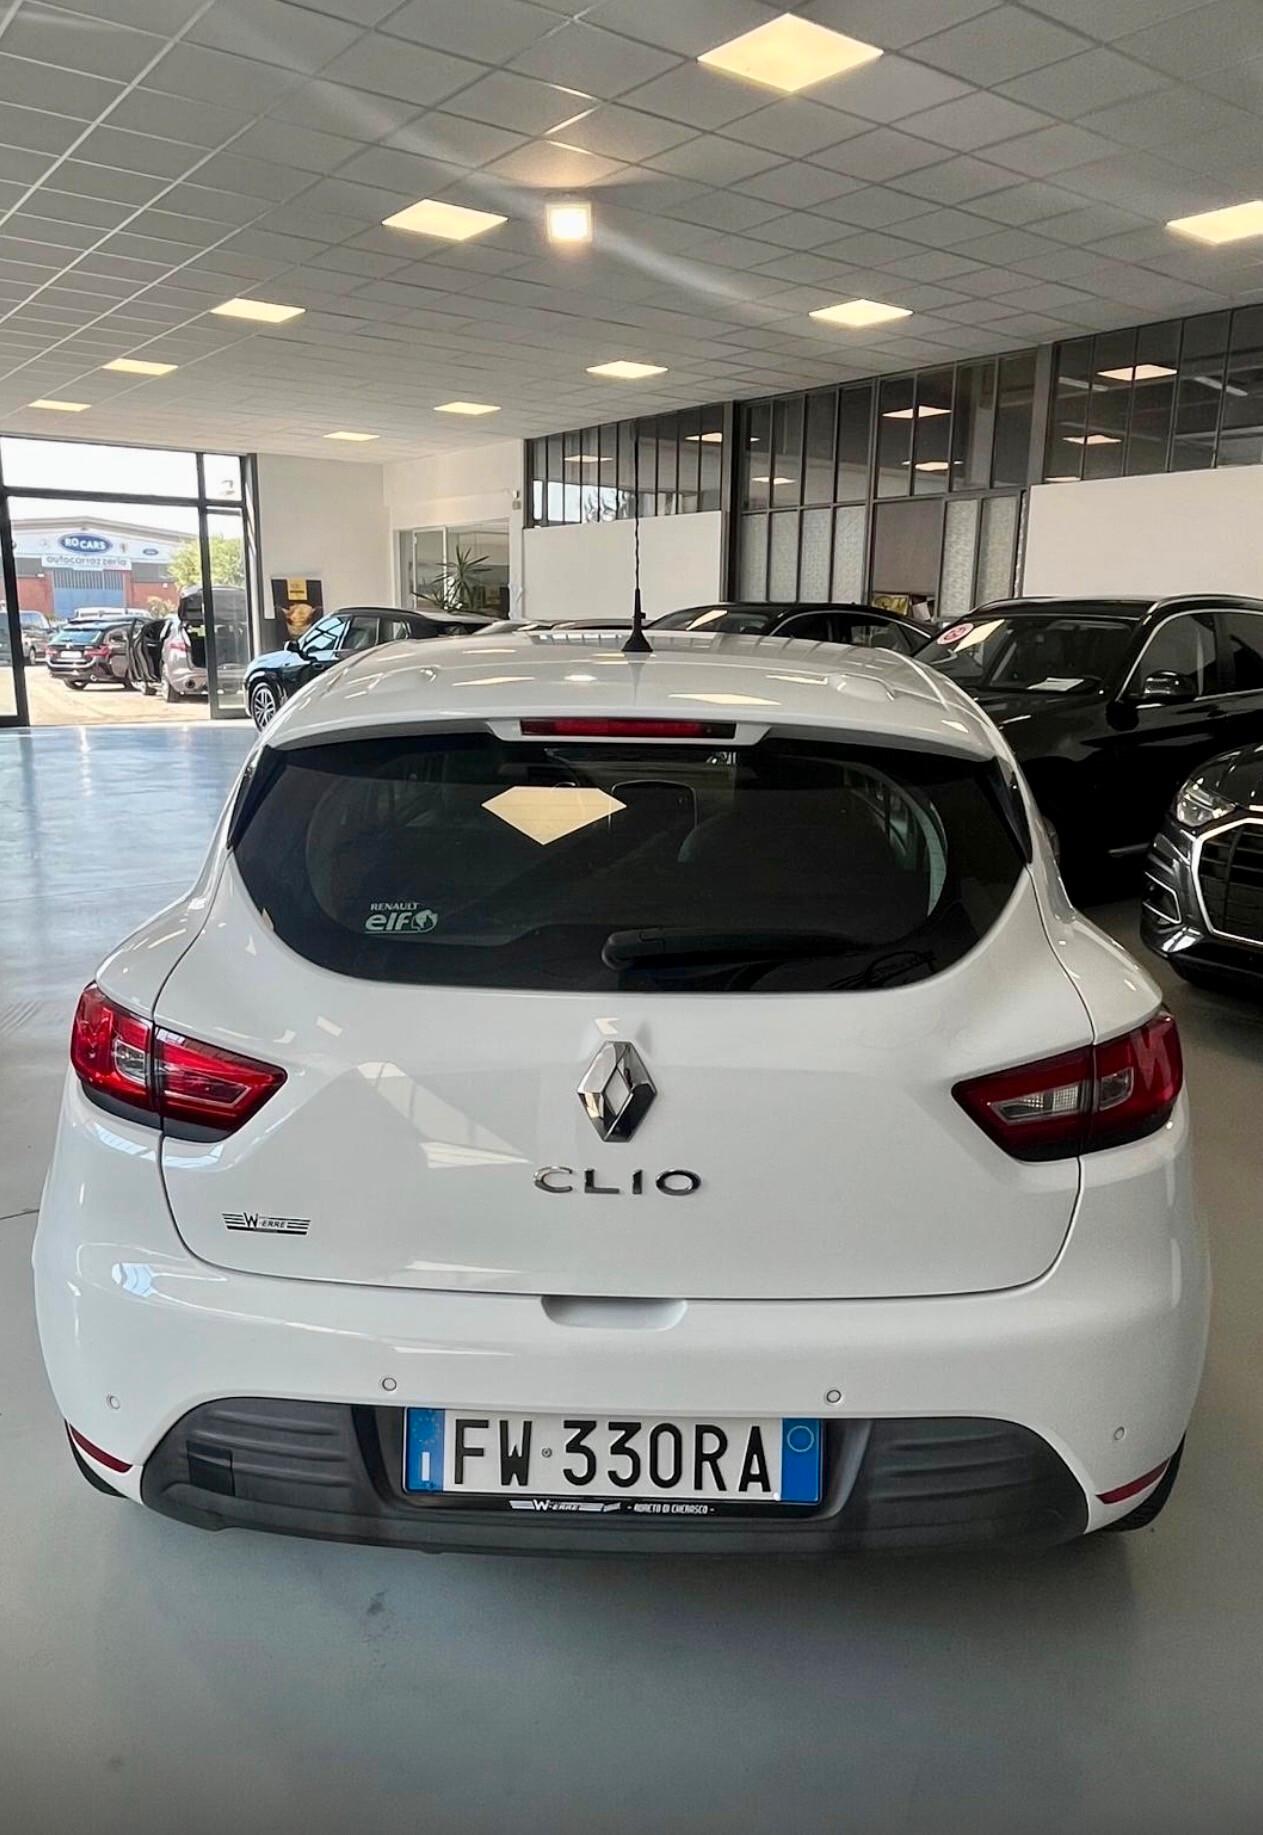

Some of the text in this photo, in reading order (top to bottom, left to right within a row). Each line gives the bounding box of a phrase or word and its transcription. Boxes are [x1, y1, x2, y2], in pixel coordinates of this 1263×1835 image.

[80, 540, 106, 550] CARS
[370, 902, 418, 911] RENAULT
[365, 912, 413, 930] elf
[533, 1165, 702, 1197] CLIO
[454, 1418, 533, 1487] FW
[561, 1419, 773, 1493] 330RA
[662, 1504, 671, 1514] DI
